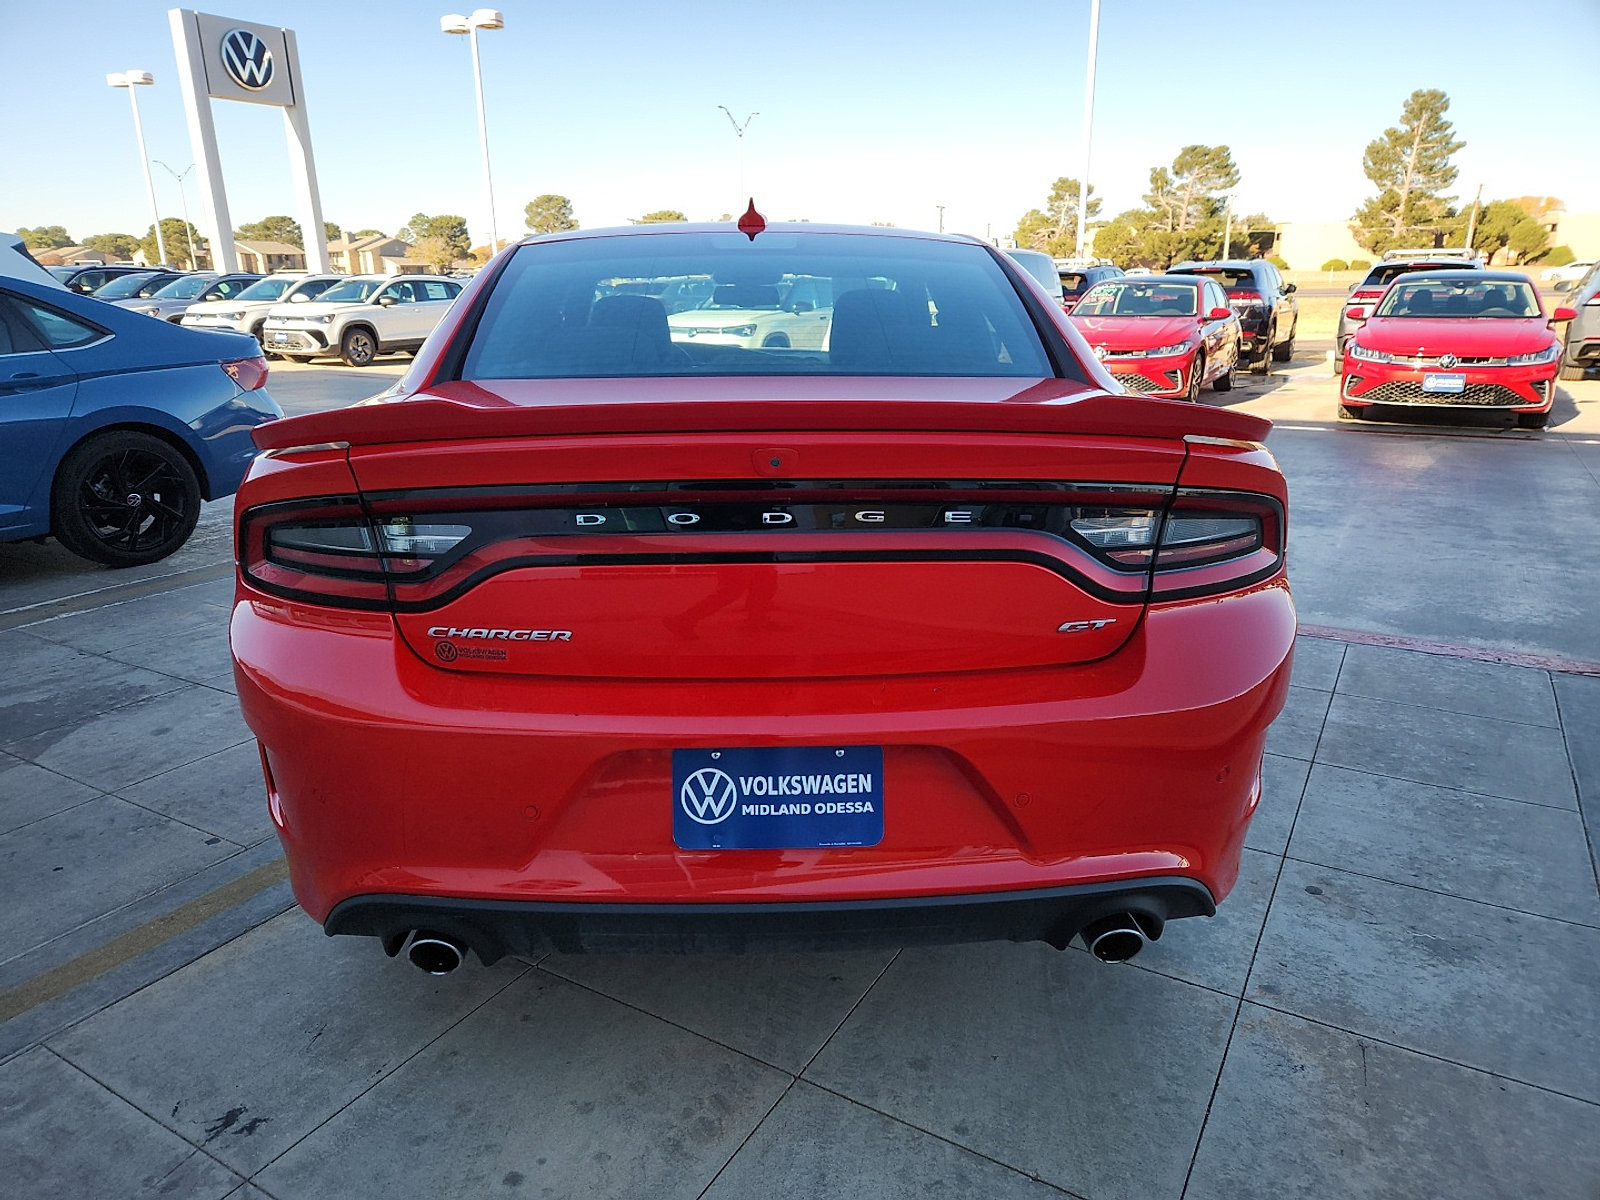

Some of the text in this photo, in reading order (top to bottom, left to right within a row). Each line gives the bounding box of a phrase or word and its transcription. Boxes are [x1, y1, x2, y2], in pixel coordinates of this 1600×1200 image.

[222, 30, 274, 89] VW
[576, 510, 972, 526] DODGE
[427, 626, 573, 641] CHARGER
[1058, 618, 1117, 633] GT
[739, 774, 872, 796] VOLKSWAGEN
[682, 768, 737, 824] VW
[742, 801, 874, 816] MIDLAND ODESSA
